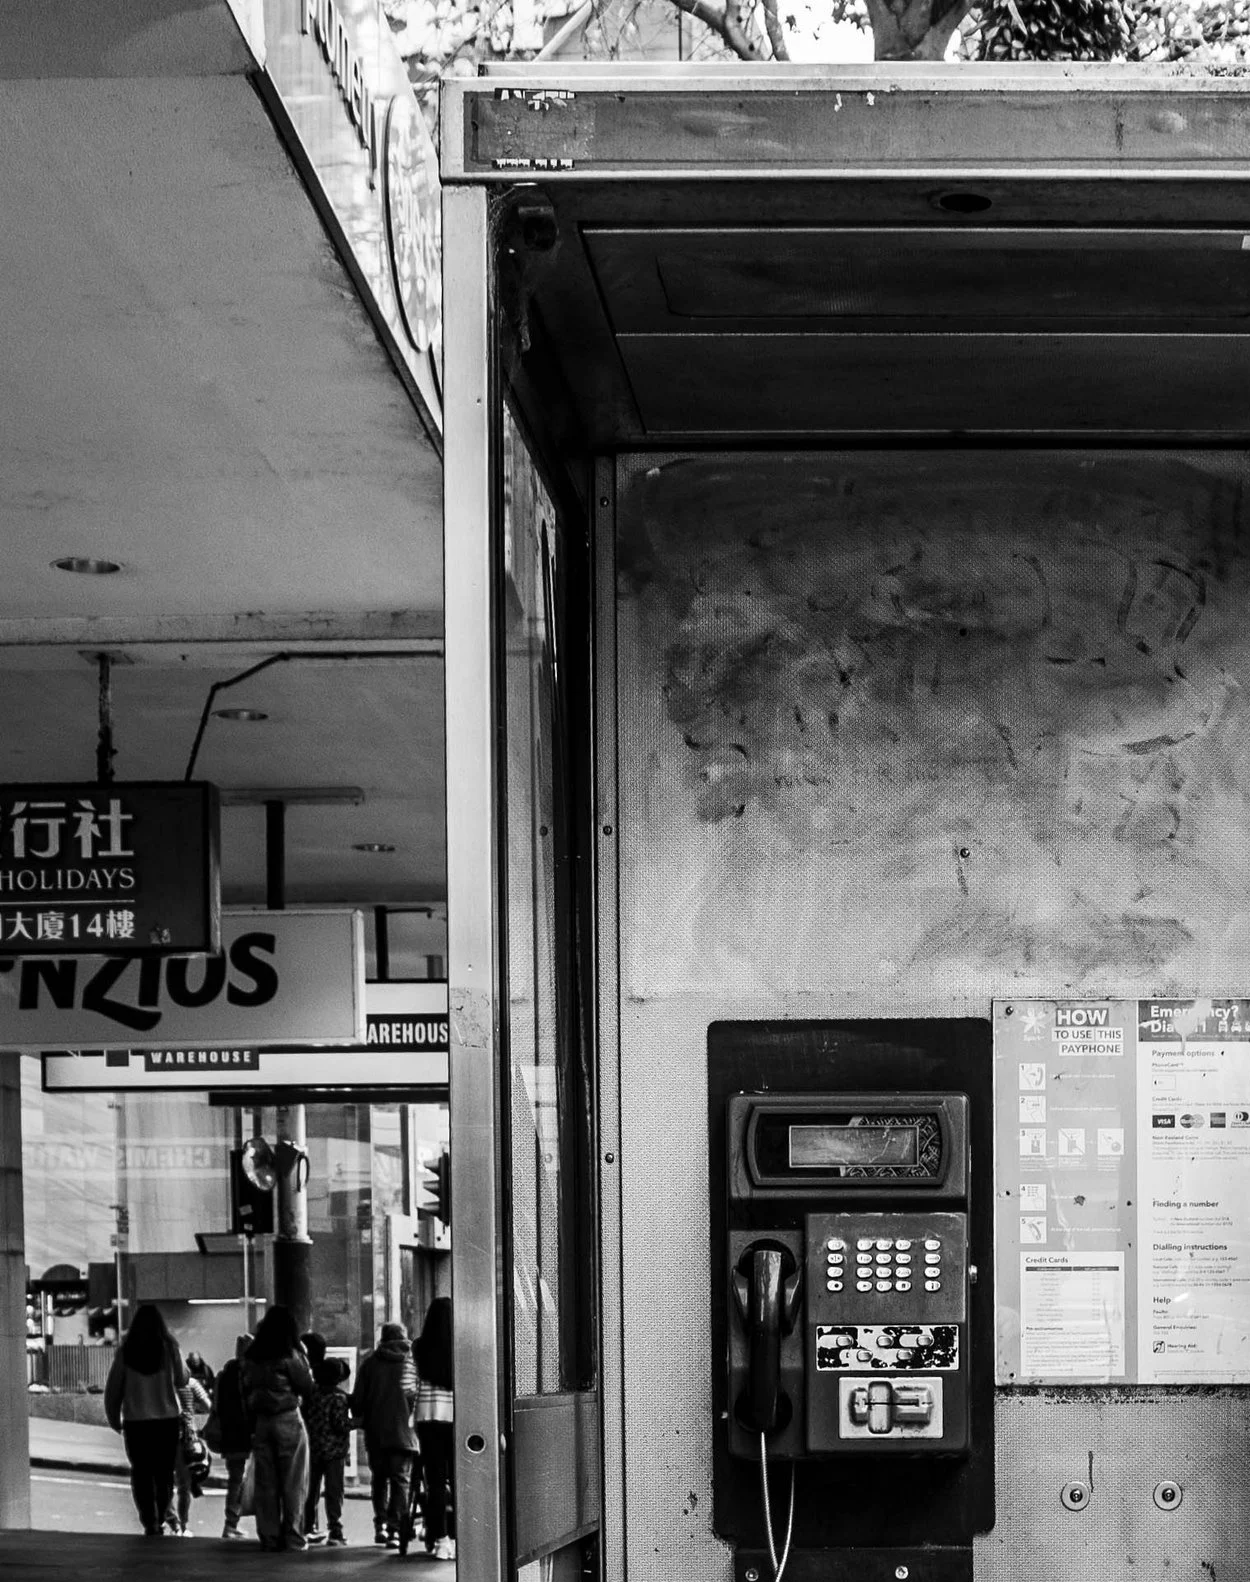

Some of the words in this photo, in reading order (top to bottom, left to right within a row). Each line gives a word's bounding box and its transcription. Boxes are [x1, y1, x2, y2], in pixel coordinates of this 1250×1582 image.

[10, 799, 134, 858] 行社
[0, 868, 135, 890] HOLIDAYS
[0, 909, 135, 940] 大廈14樓
[1057, 1009, 1107, 1025] HOW
[1054, 1030, 1069, 1039] TO
[1072, 1030, 1092, 1039] USE
[1098, 1030, 1121, 1039] THIS
[1061, 1044, 1121, 1053] PAYPHONE
[151, 1051, 252, 1064] WAREHOUSE
[1187, 1050, 1215, 1058] options
[1152, 1200, 1181, 1209] Finding
[1152, 1243, 1182, 1252] Dialling
[1184, 1243, 1228, 1251] instructions
[1025, 1256, 1047, 1264] Credit
[1048, 1256, 1069, 1264] Cards
[1152, 1296, 1172, 1305] Help
